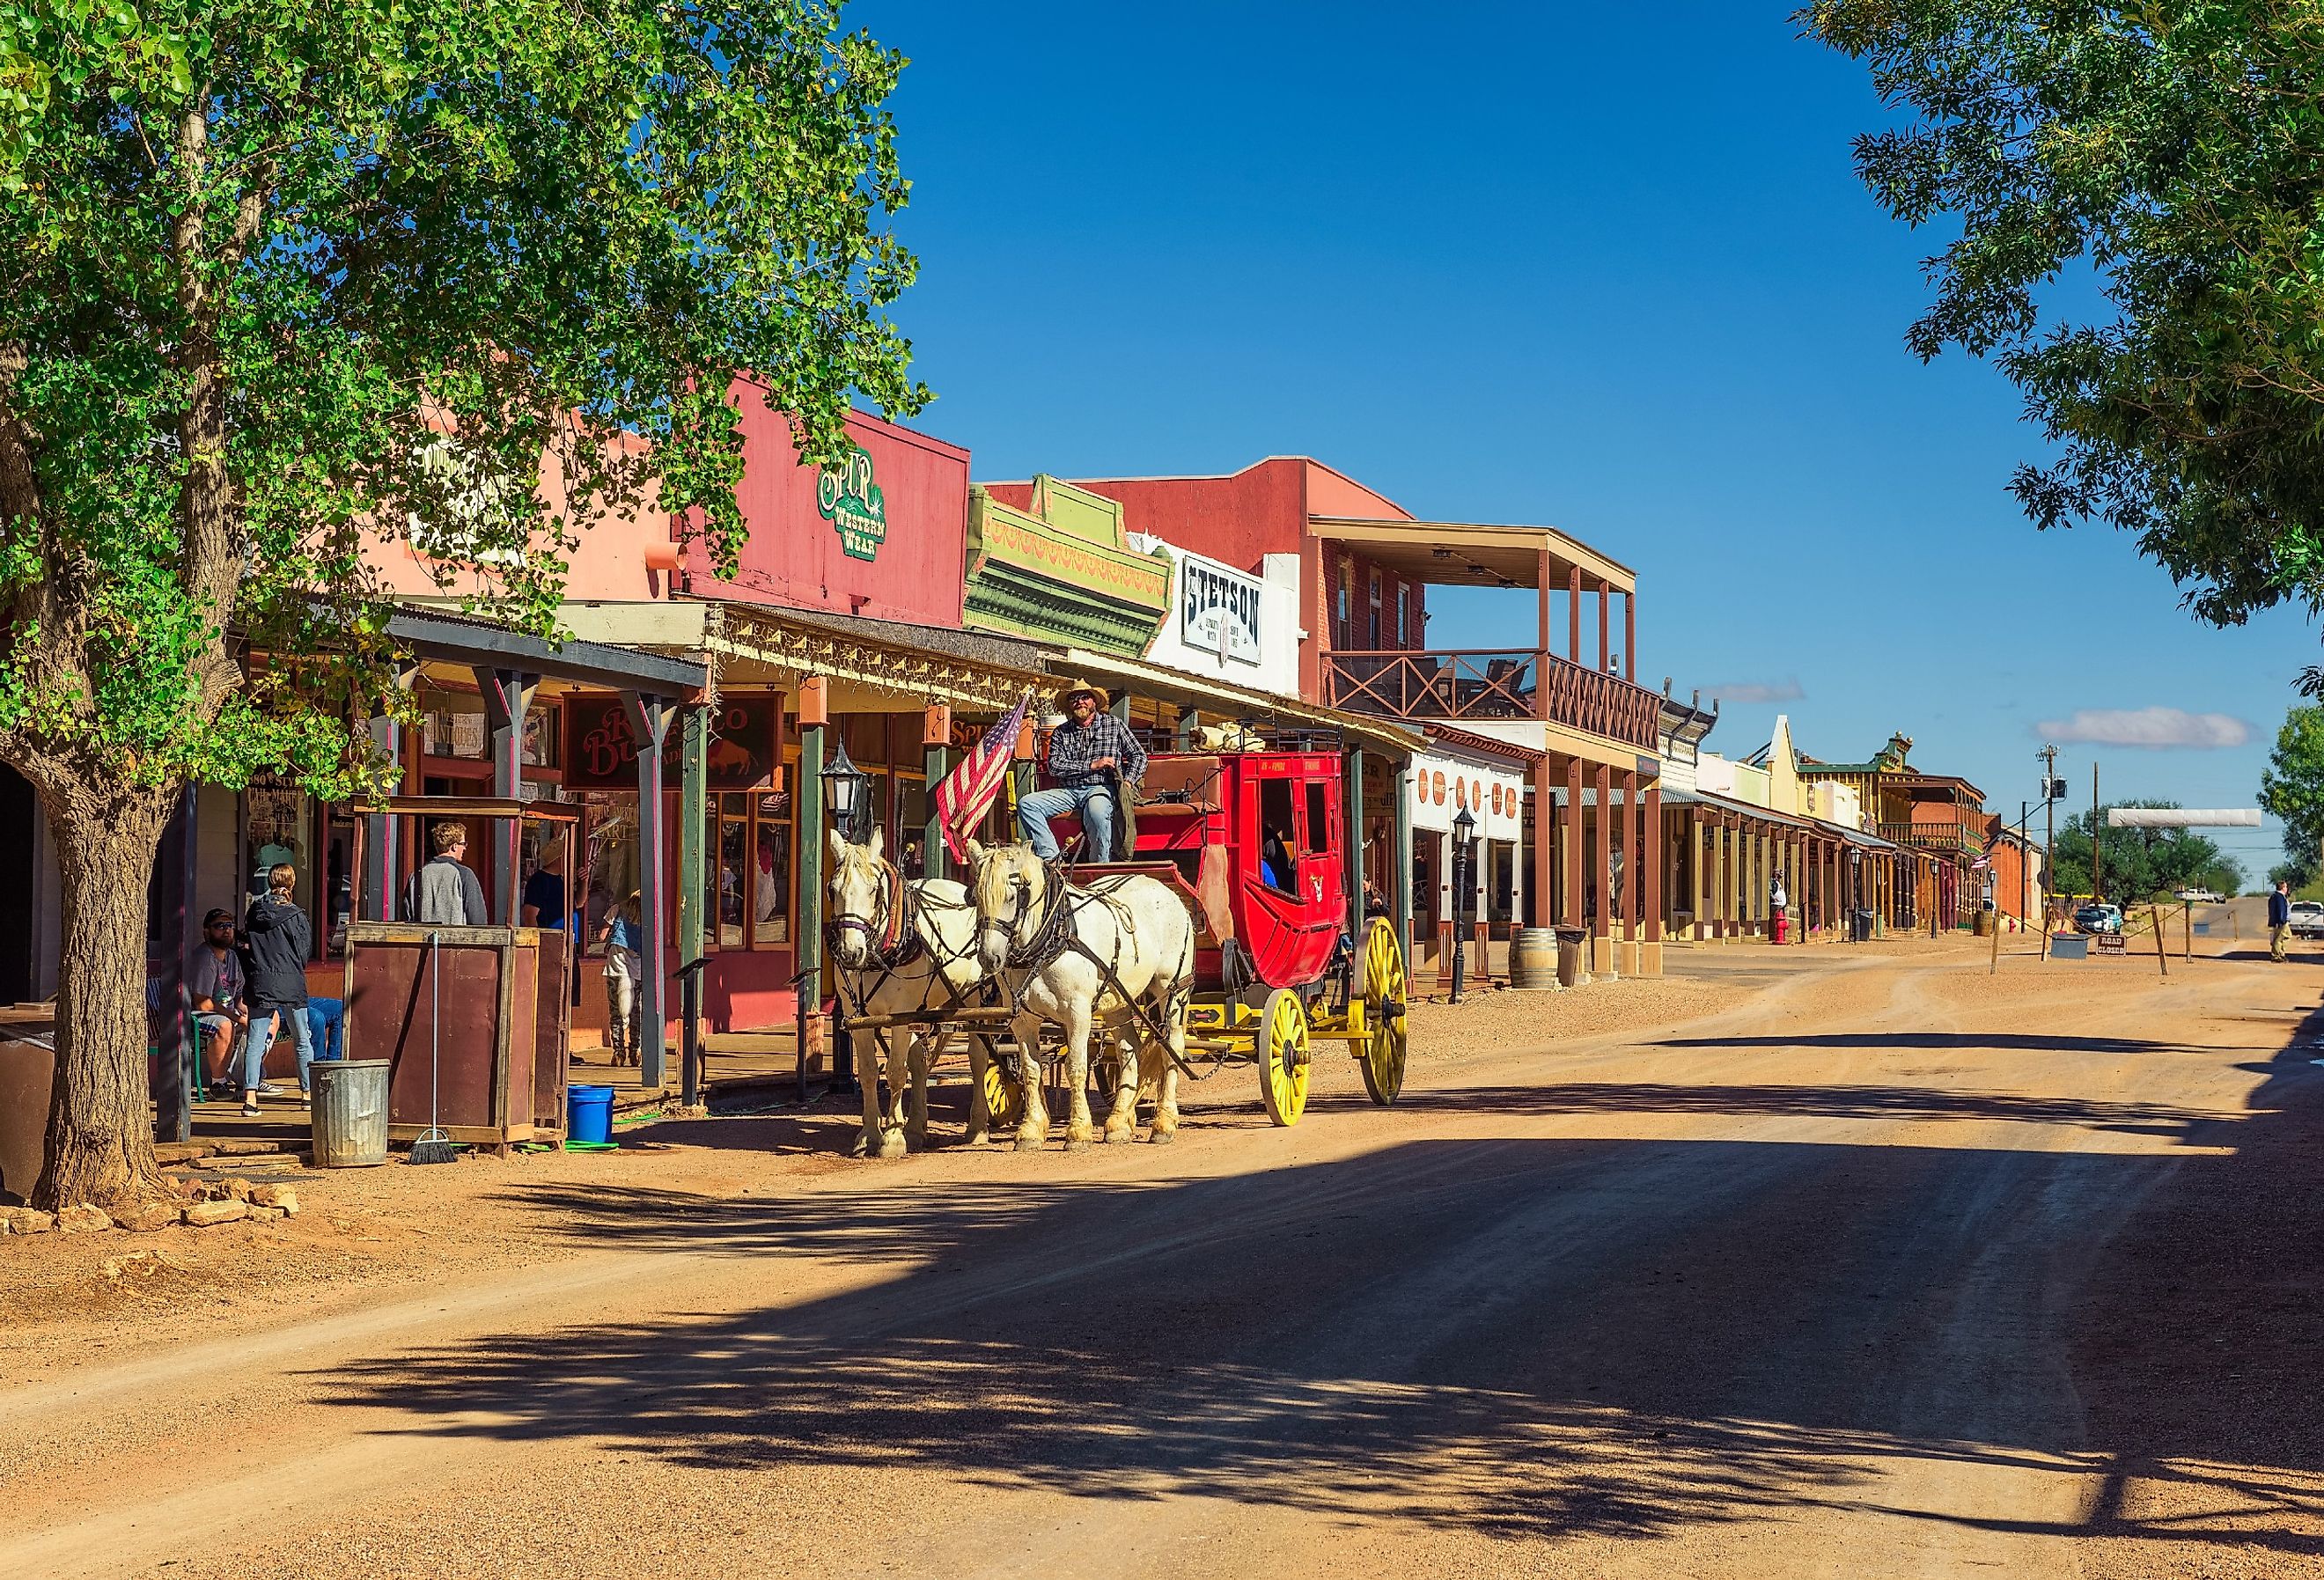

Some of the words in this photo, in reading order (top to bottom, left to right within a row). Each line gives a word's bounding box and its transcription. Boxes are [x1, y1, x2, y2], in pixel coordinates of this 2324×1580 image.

[820, 452, 872, 511] SPUR
[835, 506, 885, 538] WESTERN
[844, 530, 875, 556] WEAR
[1188, 565, 1260, 647] STETSON
